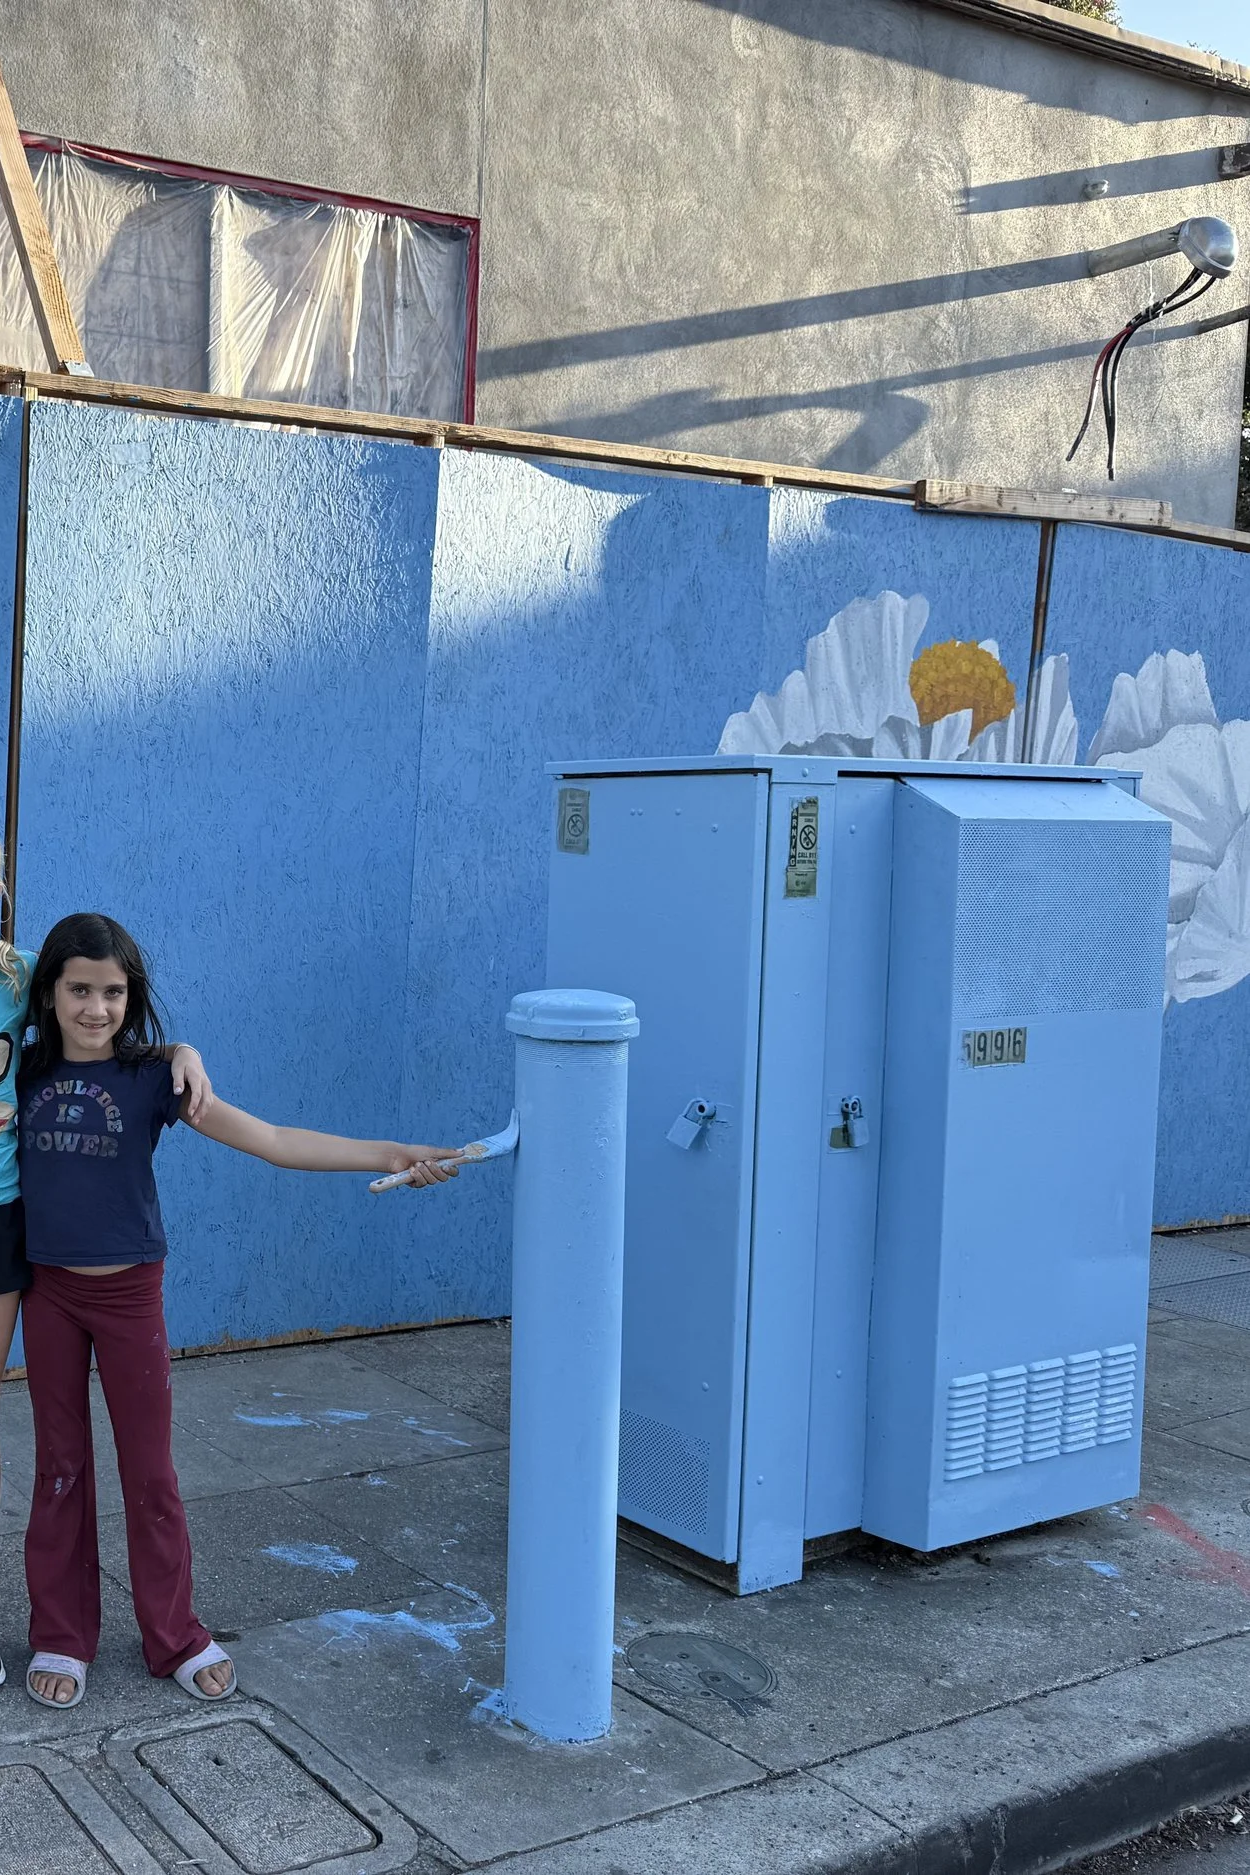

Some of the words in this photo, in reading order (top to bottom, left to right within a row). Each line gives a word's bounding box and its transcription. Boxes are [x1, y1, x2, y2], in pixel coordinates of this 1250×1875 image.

[24, 1080, 123, 1133] KNOWLEDGE
[56, 1104, 84, 1124] IS
[24, 1131, 119, 1158] POWER
